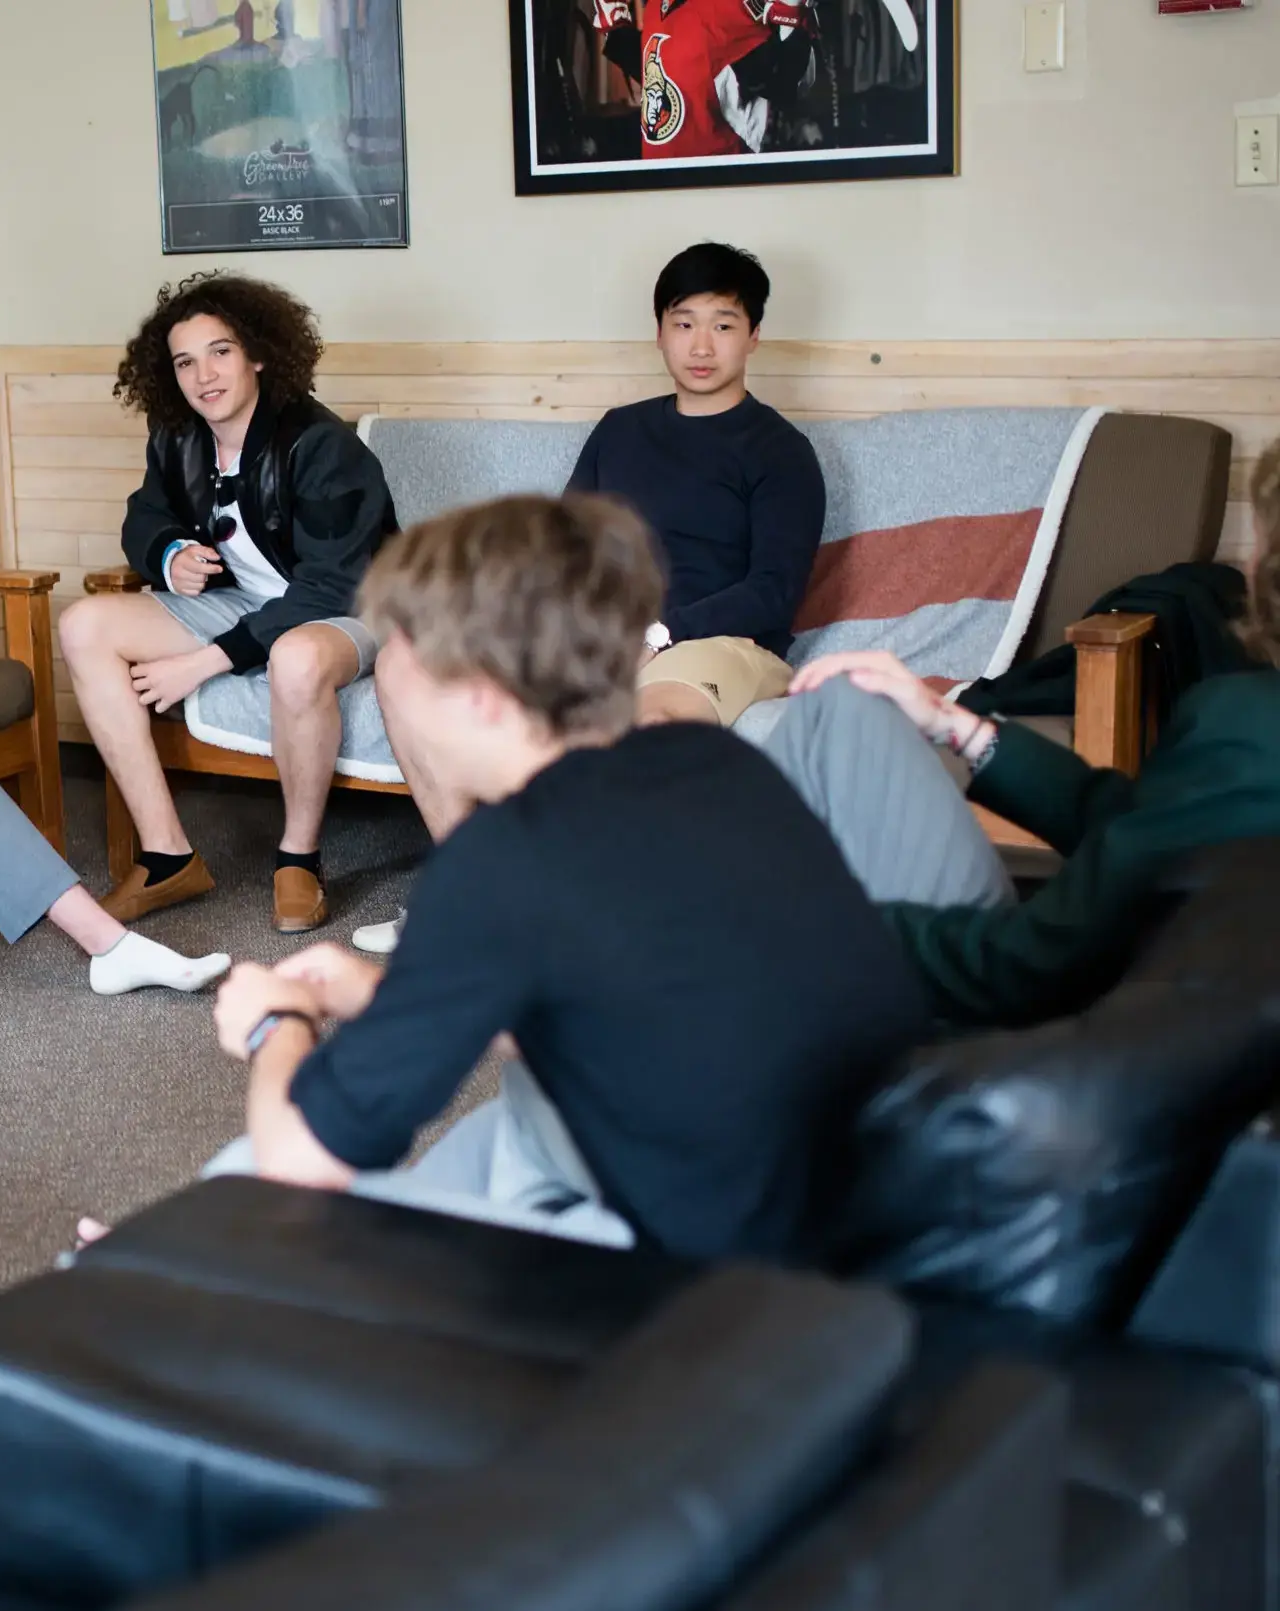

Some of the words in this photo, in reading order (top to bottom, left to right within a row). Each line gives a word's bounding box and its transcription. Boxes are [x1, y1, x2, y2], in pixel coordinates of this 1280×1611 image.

[259, 170, 309, 182] GALLERY
[259, 204, 304, 222] 24x36
[262, 226, 280, 235] BASIC
[281, 226, 300, 234] BLACK
